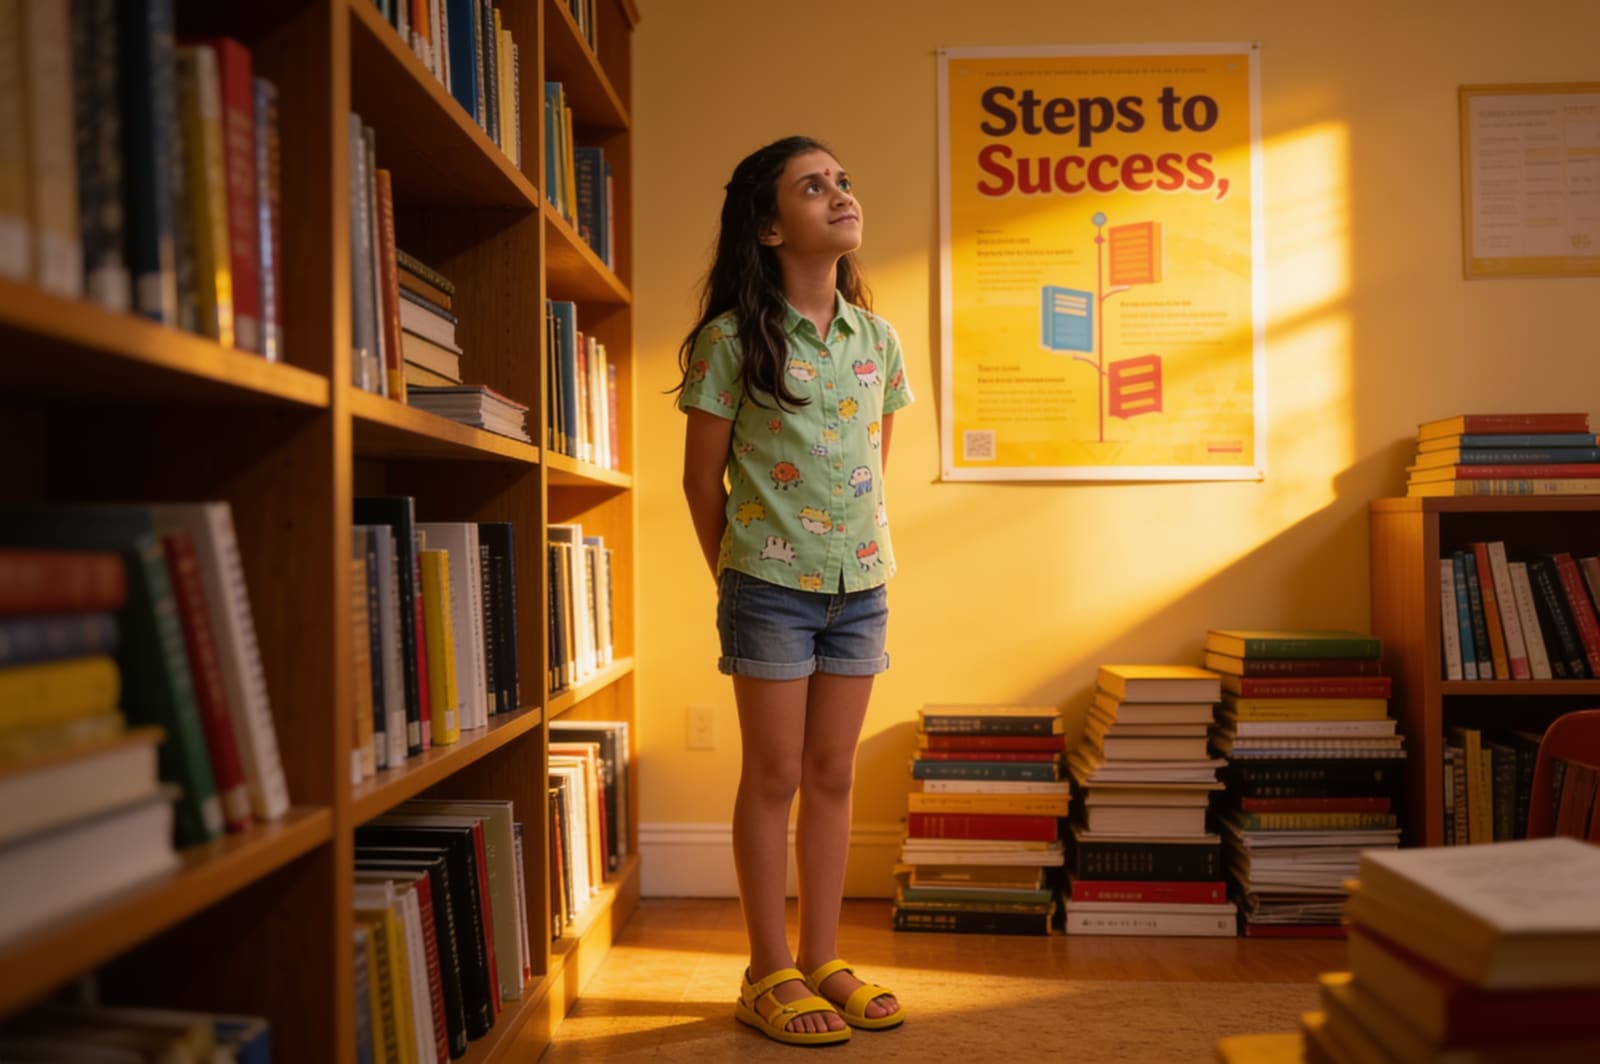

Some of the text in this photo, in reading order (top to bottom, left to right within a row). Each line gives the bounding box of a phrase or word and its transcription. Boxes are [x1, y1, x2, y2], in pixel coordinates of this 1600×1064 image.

[980, 86, 1219, 147] Steps to
[977, 143, 1230, 200] Success,
